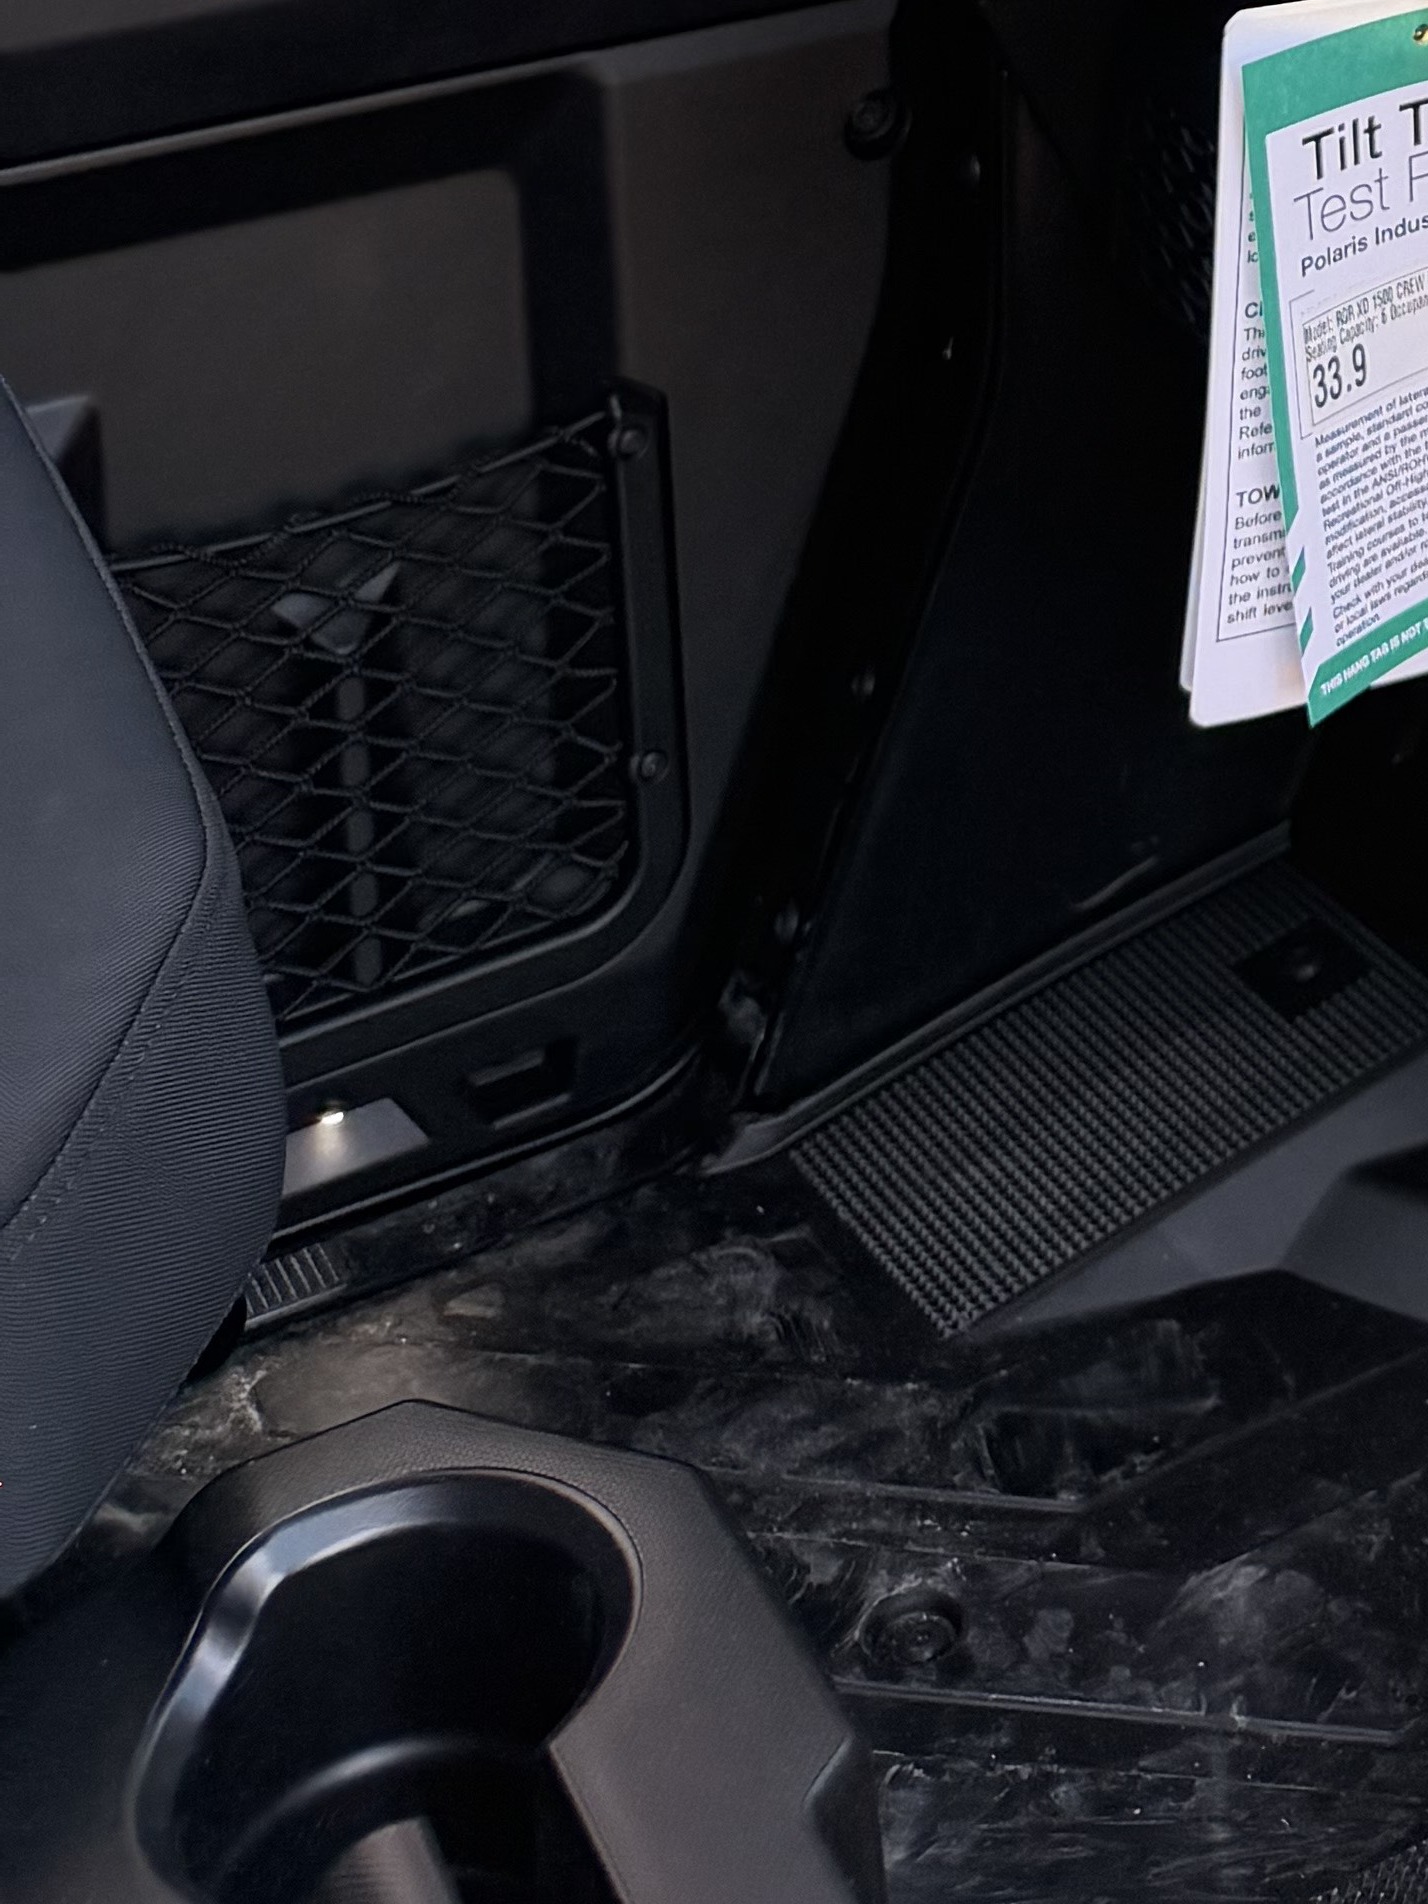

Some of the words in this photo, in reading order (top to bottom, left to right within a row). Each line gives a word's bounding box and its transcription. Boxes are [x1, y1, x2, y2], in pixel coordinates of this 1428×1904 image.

[1302, 115, 1383, 181] Tilt
[1293, 167, 1391, 241] Test
[1301, 235, 1368, 278] Polaris
[1302, 317, 1332, 343] Model:
[1356, 297, 1369, 317] XD
[1372, 286, 1393, 308] 1500
[1396, 274, 1424, 299] CREW
[1311, 341, 1368, 409] 33.9
[1240, 406, 1261, 421] the
[1315, 406, 1382, 446] Measurement
[1385, 398, 1396, 411] of
[1366, 405, 1412, 435] standard
[1317, 447, 1358, 475] operator
[1361, 435, 1381, 452] and
[1383, 431, 1390, 441] a
[1318, 477, 1330, 490] as
[1332, 448, 1381, 482] measured
[1384, 443, 1396, 455] by
[1399, 433, 1417, 447] the
[1320, 466, 1377, 503] accordance
[1379, 454, 1401, 470] with
[1404, 445, 1421, 458] the
[1235, 510, 1282, 530] Before
[1321, 499, 1340, 516] test
[1341, 494, 1351, 506] in
[1353, 484, 1369, 499] the
[1323, 490, 1383, 530] Recreational
[1326, 536, 1352, 559] affect
[1354, 517, 1384, 541] lateral
[1327, 546, 1364, 572] Training
[1366, 524, 1405, 550] courses
[1407, 517, 1418, 528] to
[1230, 571, 1261, 587] how
[1266, 567, 1280, 579] to
[1329, 563, 1360, 588] driving
[1362, 553, 1378, 568] are
[1330, 583, 1350, 604] your
[1353, 564, 1381, 587] dealer
[1384, 545, 1416, 568] and/or
[1227, 606, 1257, 623] shift
[1229, 591, 1251, 606] the
[1332, 594, 1361, 619] Check
[1364, 581, 1384, 598] with
[1385, 568, 1407, 588] your
[1334, 620, 1343, 633] or
[1346, 604, 1368, 625] local
[1369, 591, 1391, 610] laws
[1321, 672, 1343, 695] THIS
[1343, 655, 1370, 682] HANG
[1370, 642, 1389, 663] TAG
[1390, 635, 1400, 653] IS
[1401, 622, 1421, 644] NOT
